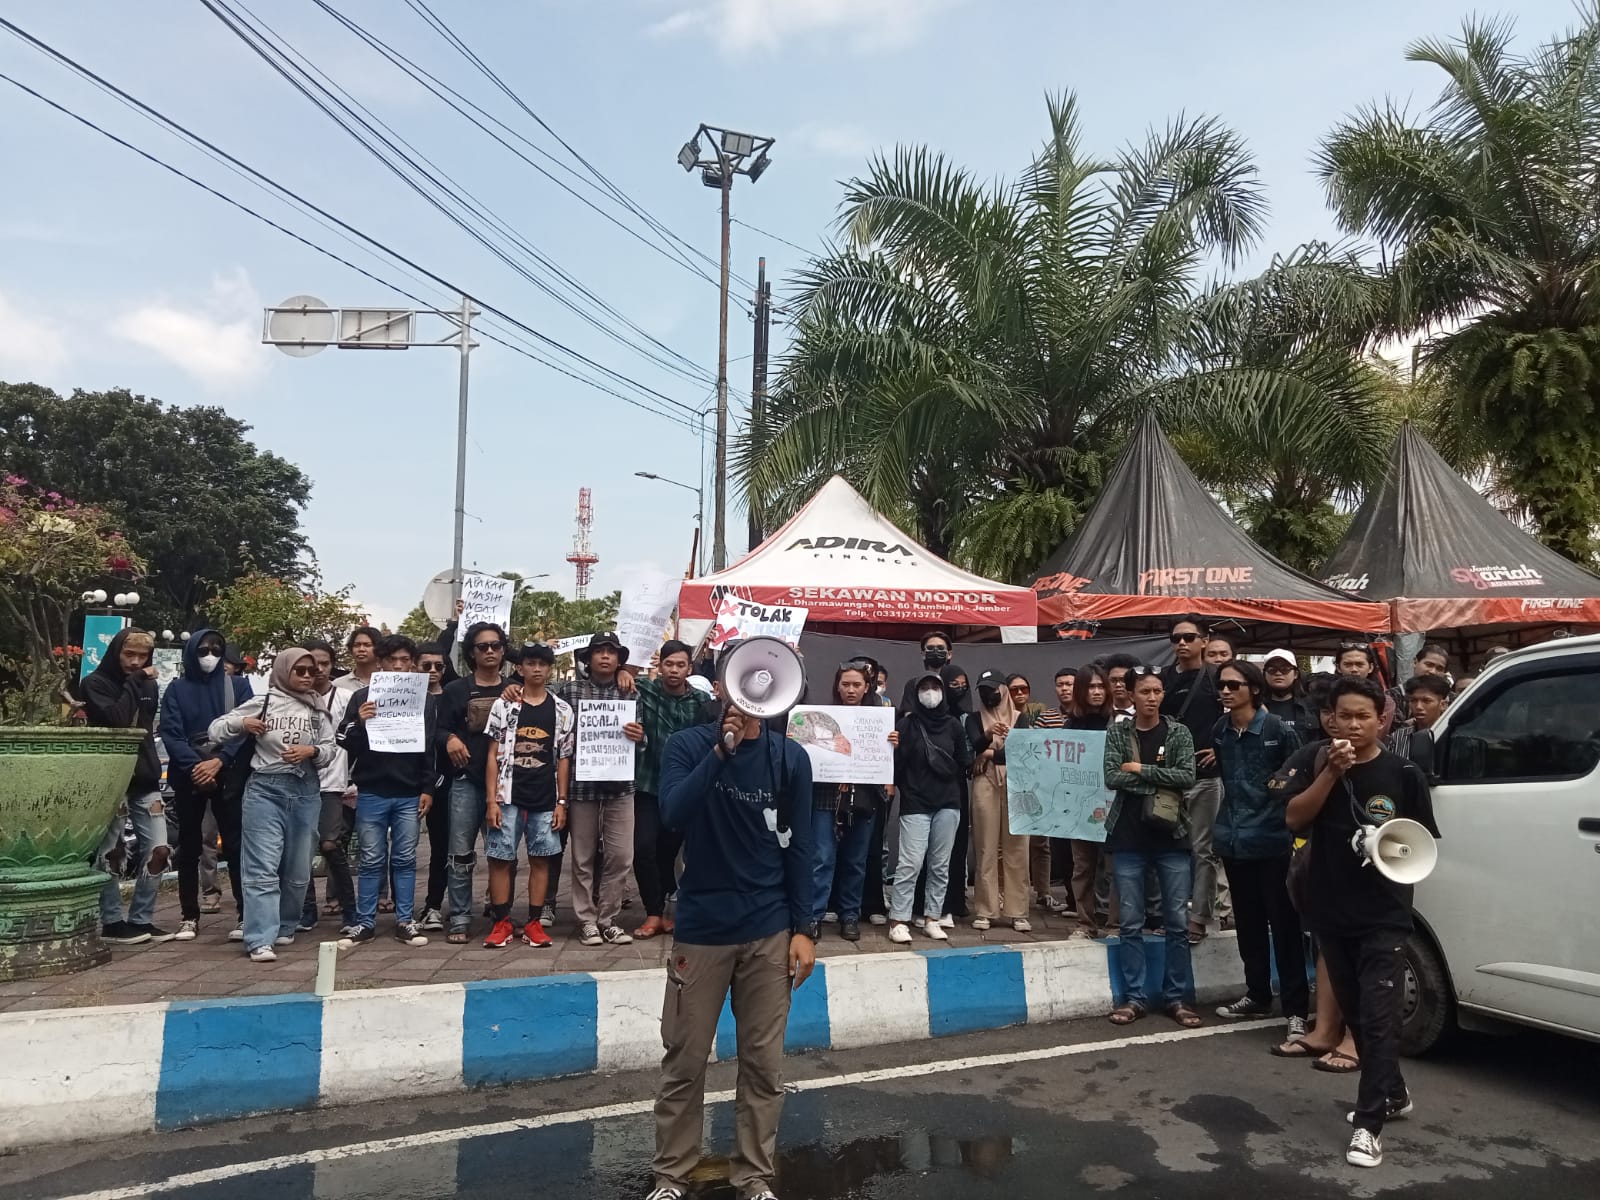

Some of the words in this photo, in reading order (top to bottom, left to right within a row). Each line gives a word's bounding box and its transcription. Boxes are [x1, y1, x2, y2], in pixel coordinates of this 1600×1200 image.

[784, 536, 914, 556] ADIRA
[814, 553, 918, 566] FINANCE
[1139, 567, 1204, 595] FIRST
[1205, 566, 1253, 584] ONE
[468, 590, 504, 602] MASIH
[789, 587, 906, 602] SEKAWAN
[914, 591, 997, 604] MOTOR
[794, 598, 875, 608] Dharmawangsa
[738, 601, 792, 622] TOLAK
[580, 715, 619, 728] SEGALA
[282, 732, 300, 744] 22
